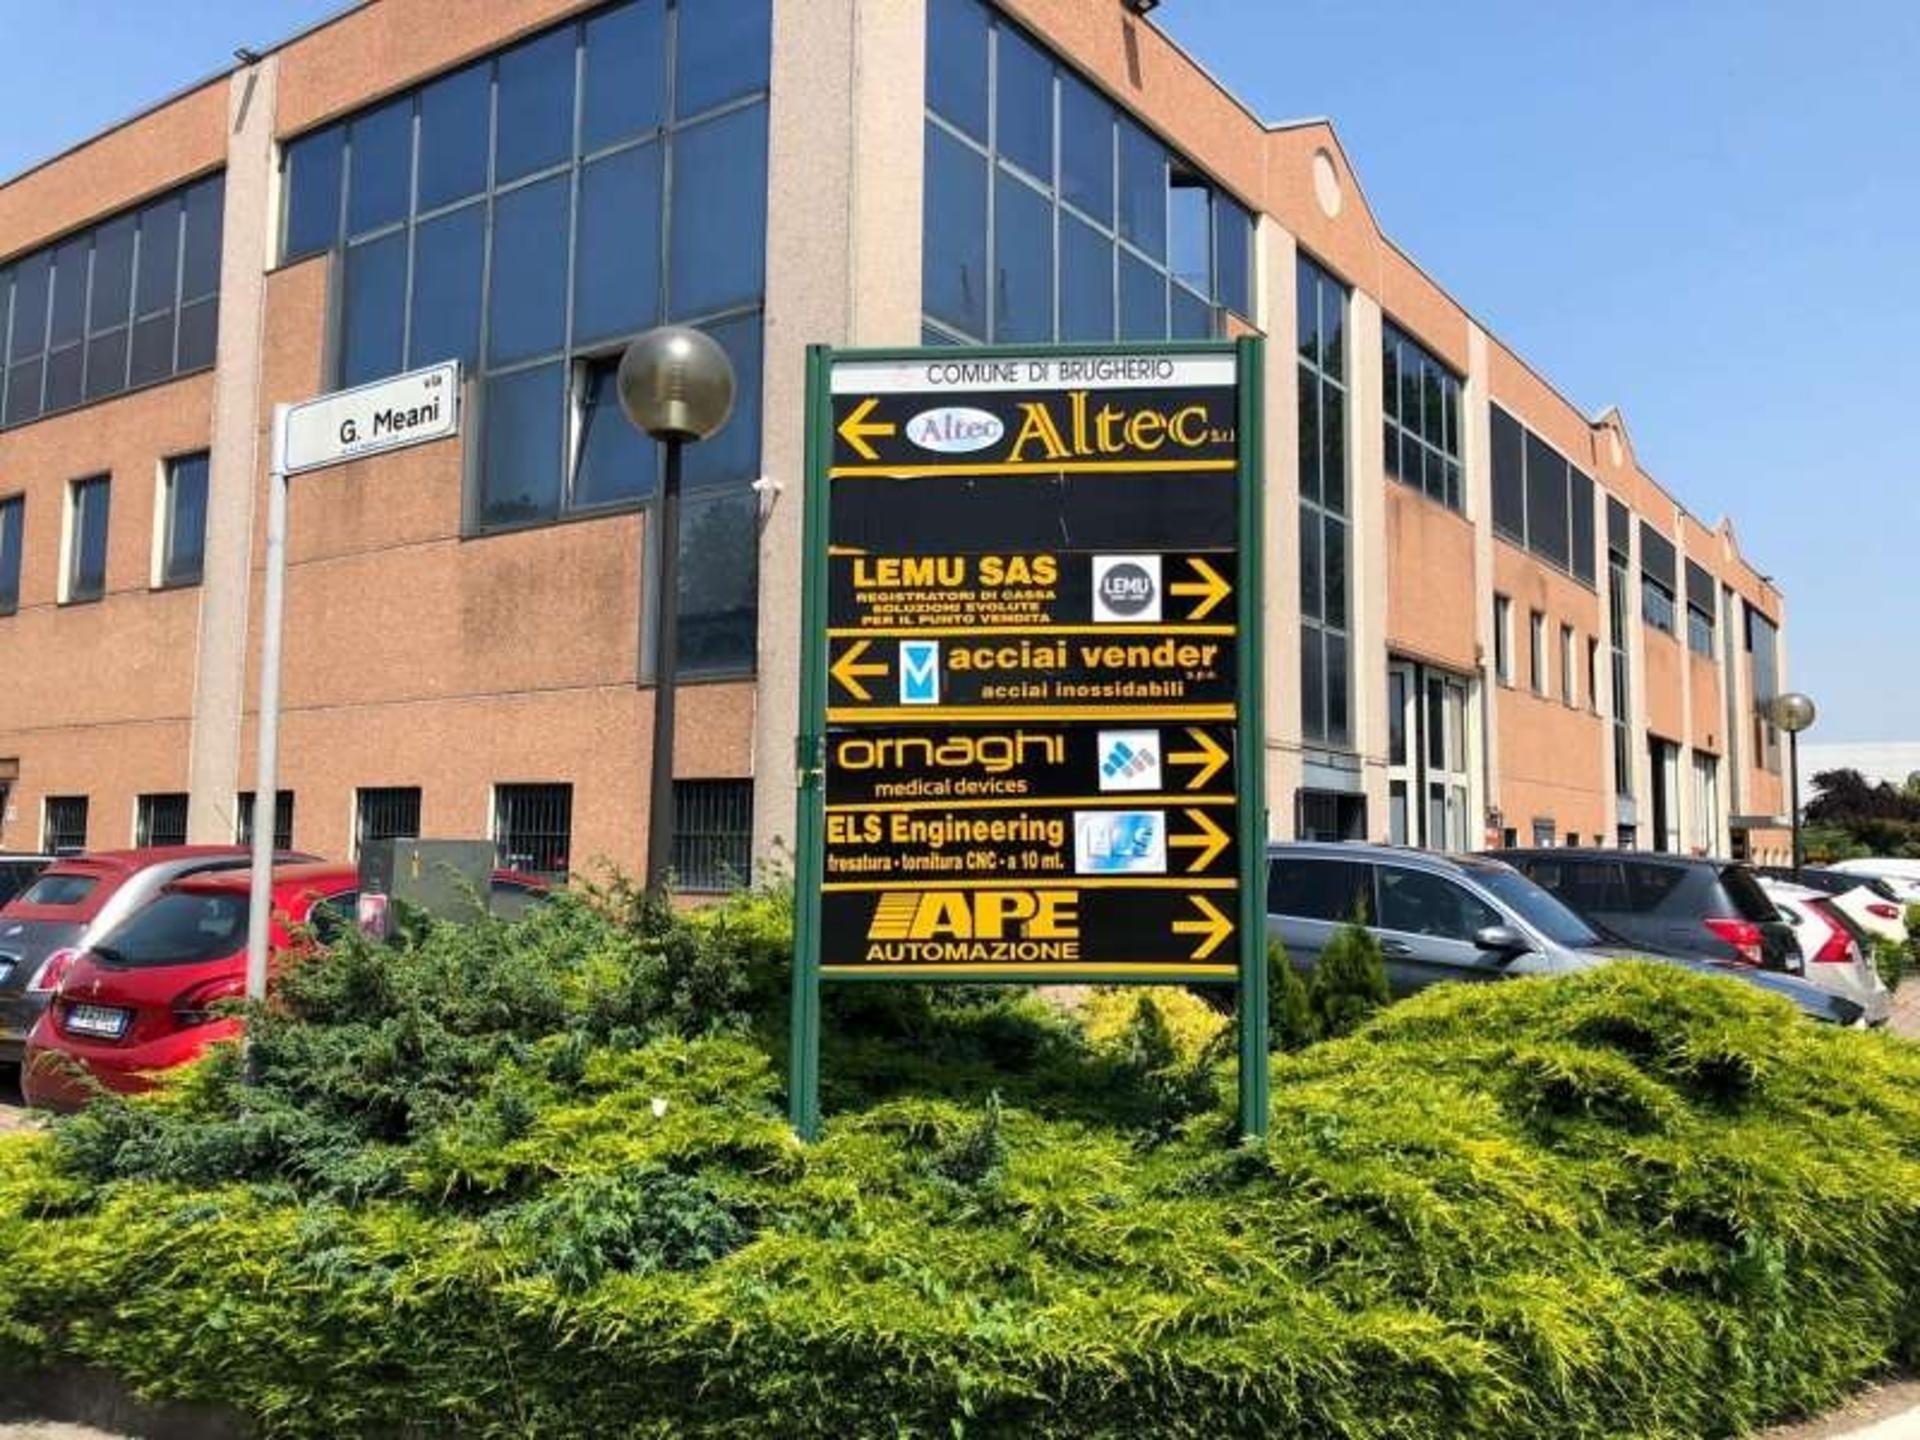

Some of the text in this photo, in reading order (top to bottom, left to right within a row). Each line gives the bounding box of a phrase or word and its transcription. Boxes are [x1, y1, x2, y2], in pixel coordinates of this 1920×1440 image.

[927, 359, 1175, 384] COMUNE DI BRUGHERIO
[340, 396, 440, 444] G. Meani
[921, 414, 998, 442] Altec
[1006, 391, 1208, 462] Altec
[853, 556, 1057, 588] LEMU SAS
[856, 592, 975, 603] REGISTRATORI
[981, 591, 997, 601] DI
[1103, 577, 1149, 594] LEMU
[862, 616, 893, 625] PER
[980, 613, 1050, 624] VENDITA
[949, 640, 1218, 670] acciai vender
[982, 681, 1184, 699] acciai inossidabili
[838, 730, 1064, 772] ornaghi
[875, 777, 1029, 798] medical devices
[827, 812, 1064, 848] ELS Engineering
[827, 852, 892, 872] fresatura
[966, 850, 997, 870] CNC
[1021, 850, 1039, 870] 10
[906, 891, 1079, 939] APE
[866, 942, 1080, 961] AUTOMAZIONE
